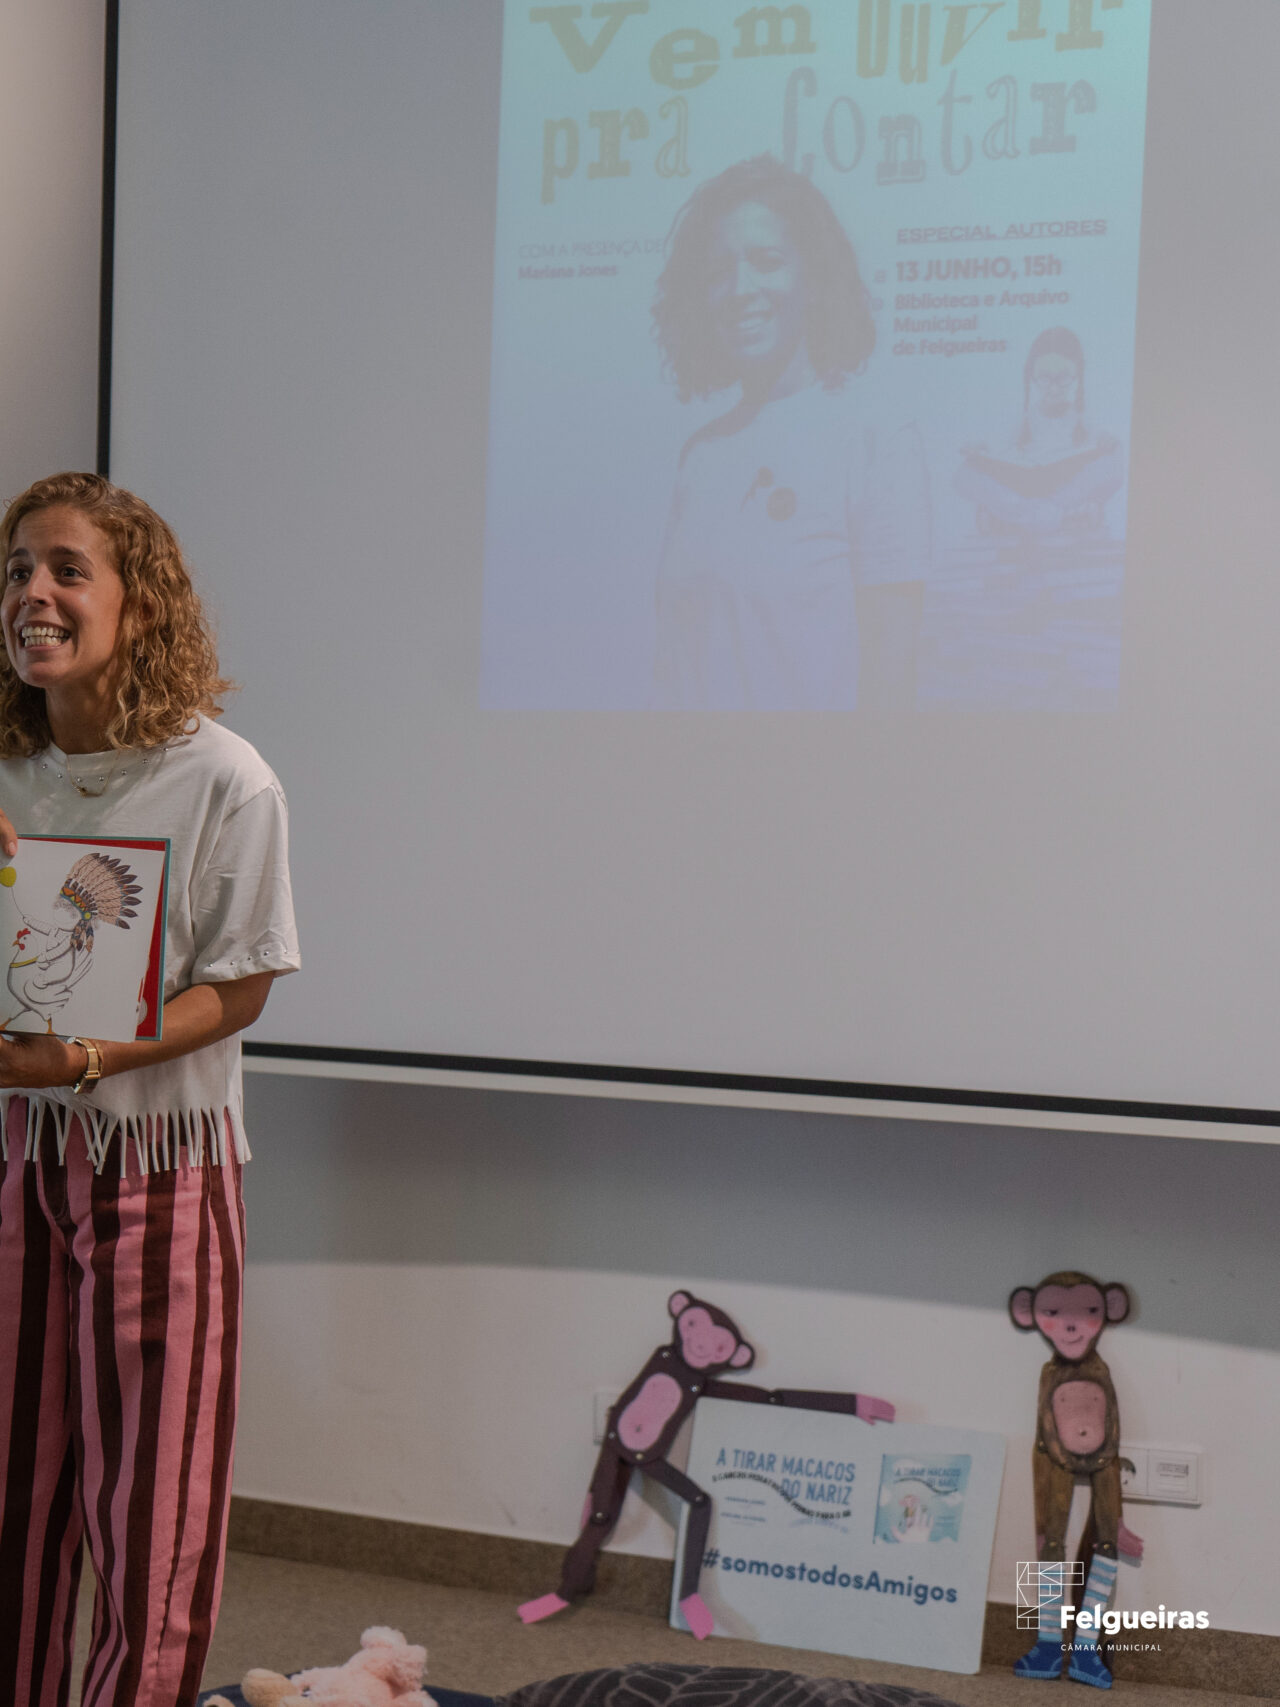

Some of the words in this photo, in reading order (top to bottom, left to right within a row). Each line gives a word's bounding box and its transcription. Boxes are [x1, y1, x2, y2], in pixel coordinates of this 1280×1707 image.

[529, 2, 816, 90] Vem
[541, 95, 691, 204] pra
[897, 224, 997, 244] ESPECIAL
[1005, 219, 1108, 239] AUTORES
[896, 260, 919, 282] 13
[924, 257, 1017, 281] JUNHO,
[1023, 254, 1062, 277] 15h
[895, 292, 979, 310] Biblioteca
[984, 294, 995, 307] e
[1000, 288, 1070, 309] Arquivo
[893, 315, 977, 334] Municipal
[892, 340, 916, 356] de
[920, 336, 1008, 357] Felgueiras
[716, 1447, 726, 1466] A
[732, 1448, 777, 1473] TIRAR
[781, 1455, 856, 1482] MACACOS
[805, 1481, 853, 1506] NARIZ
[703, 1549, 959, 1605] #somostodosAmigos
